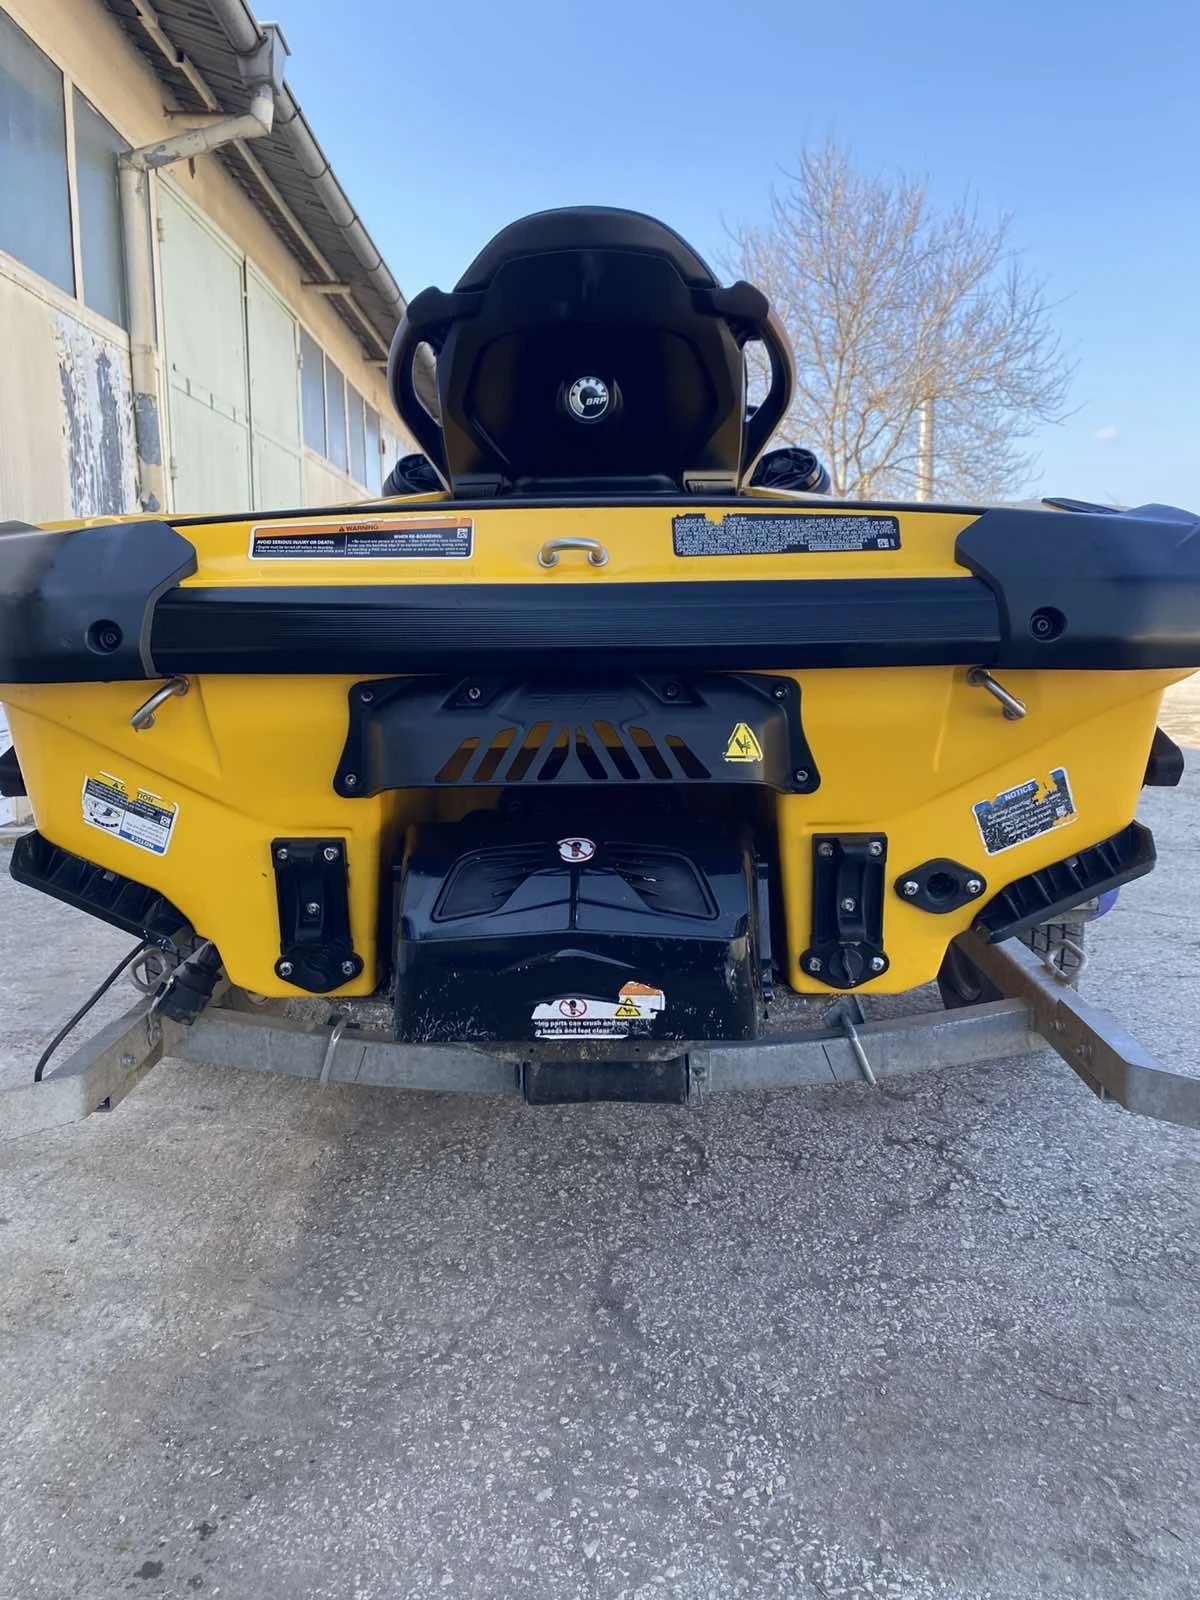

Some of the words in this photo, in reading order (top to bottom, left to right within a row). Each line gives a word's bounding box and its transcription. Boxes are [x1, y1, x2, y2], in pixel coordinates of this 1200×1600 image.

[585, 396, 607, 405] BRP
[121, 784, 154, 803] CTION
[1004, 783, 1034, 801] NOTICE
[550, 1020, 568, 1029] parts
